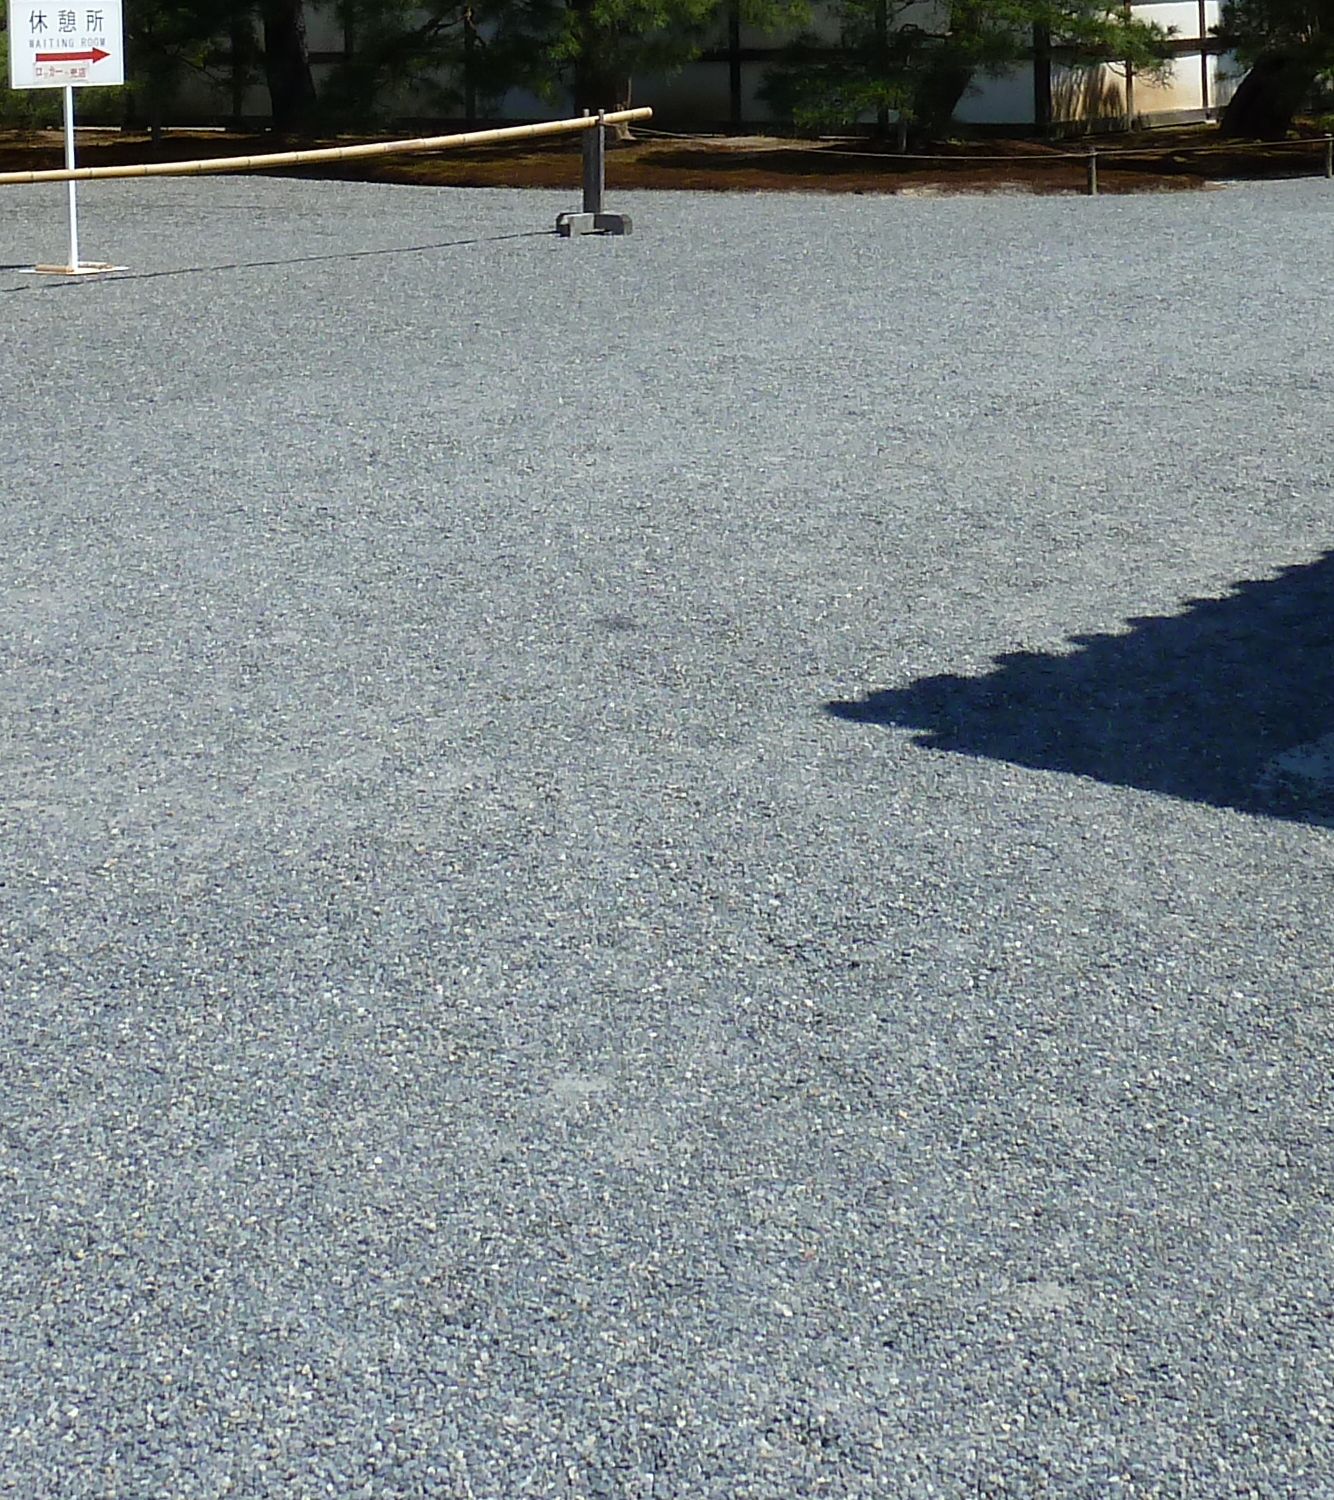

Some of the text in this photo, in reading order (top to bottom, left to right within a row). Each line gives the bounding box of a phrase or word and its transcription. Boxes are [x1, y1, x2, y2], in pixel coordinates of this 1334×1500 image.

[28, 9, 105, 34] 休憩所
[29, 37, 106, 49] WAITING ROOM
